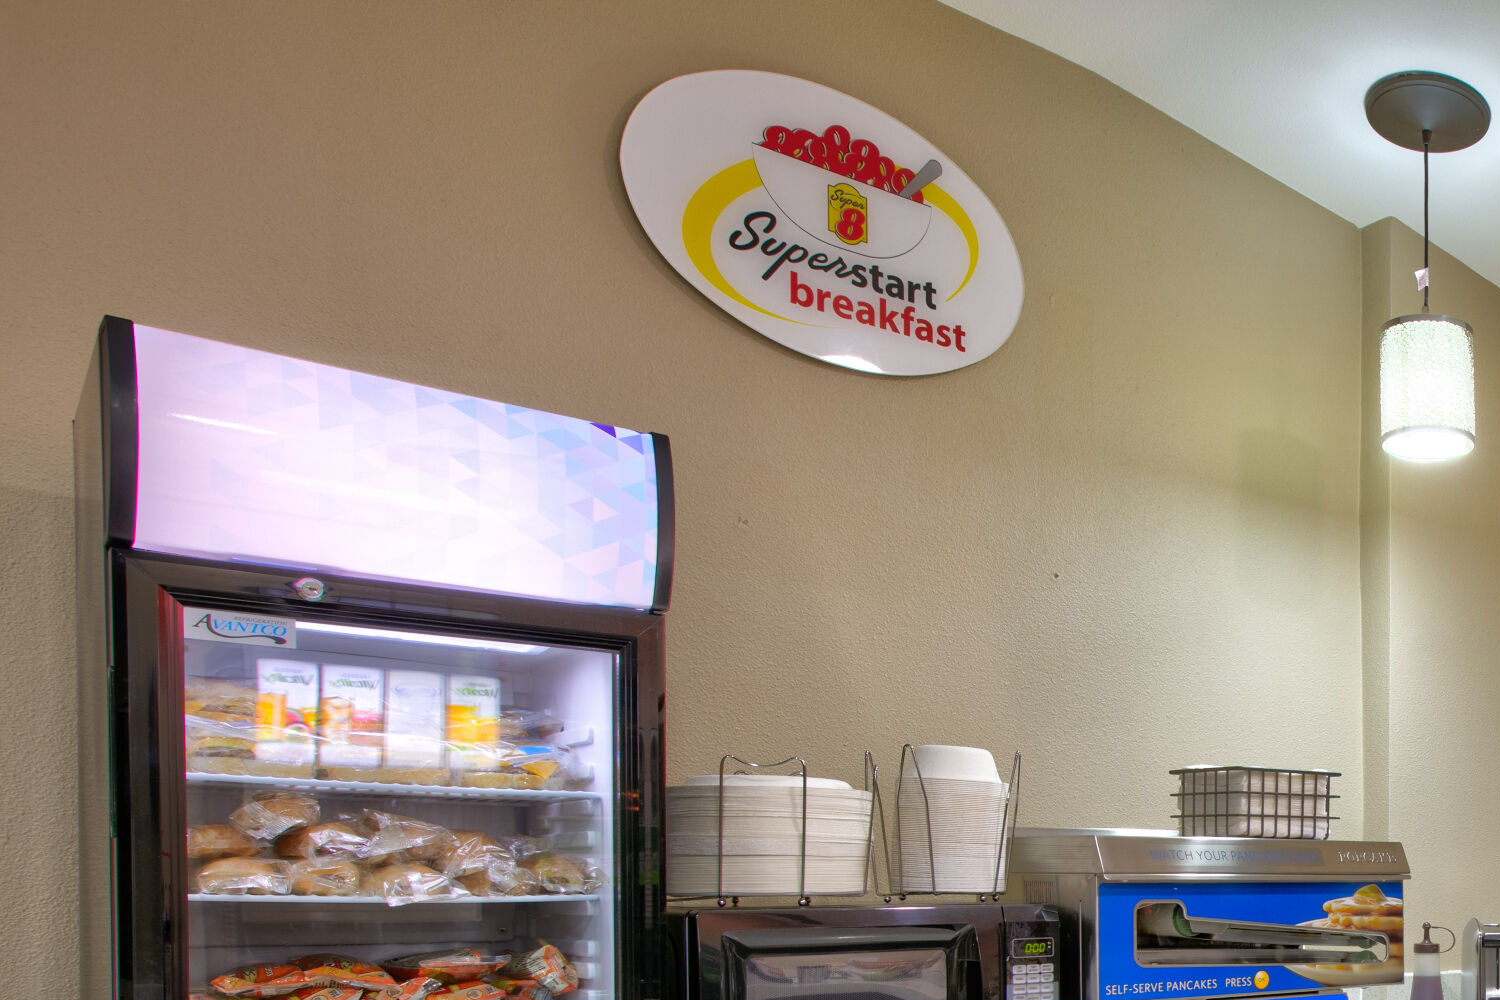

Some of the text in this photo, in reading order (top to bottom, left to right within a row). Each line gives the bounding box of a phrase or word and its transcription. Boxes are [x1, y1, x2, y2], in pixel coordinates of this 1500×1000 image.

[830, 188, 866, 209] Super
[834, 207, 866, 241] 8
[728, 211, 937, 310] Superstart
[789, 270, 967, 353] breakfast
[192, 613, 288, 638] AVANTCO
[1197, 850, 1228, 861] YOUR
[1025, 943, 1046, 953] 0:00
[1105, 982, 1164, 996] SELF-SERVE
[1166, 978, 1218, 993] PANCAKES
[1225, 976, 1252, 988] PRESS
